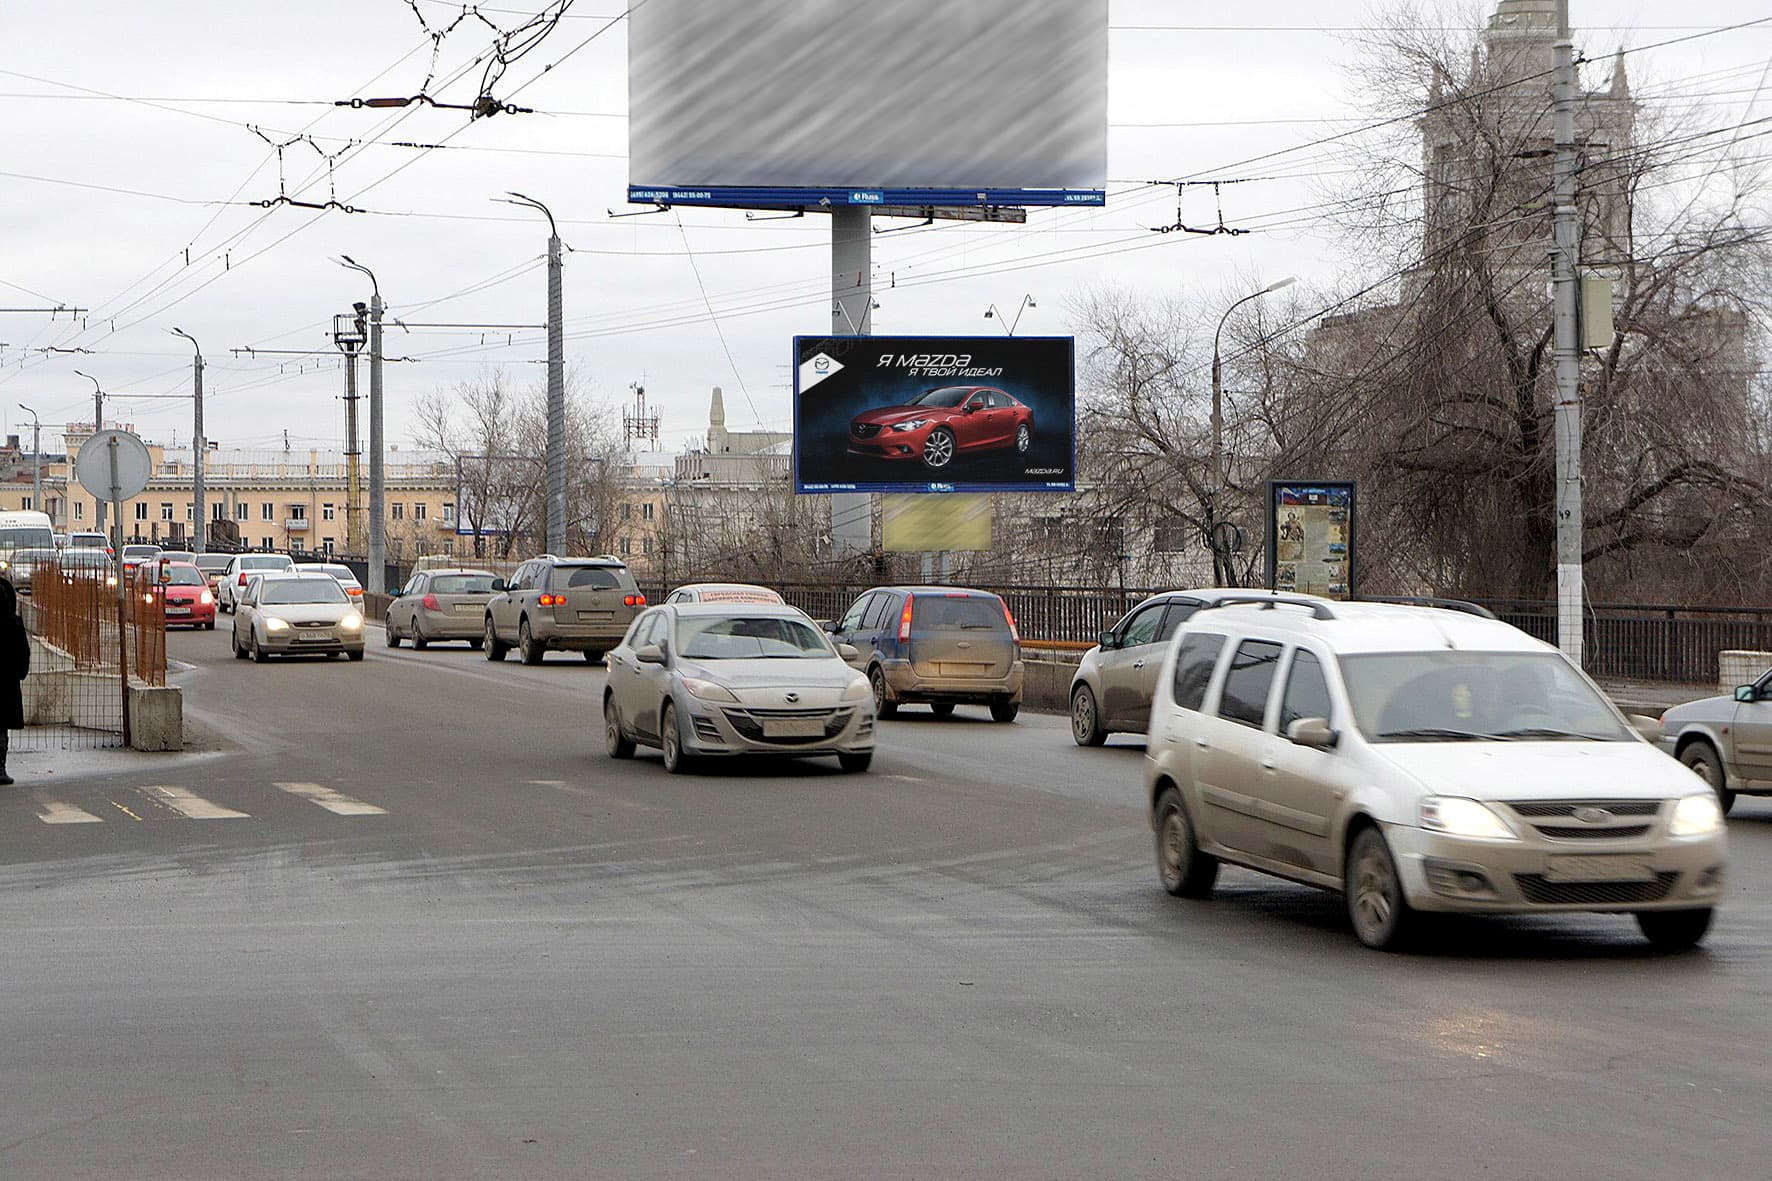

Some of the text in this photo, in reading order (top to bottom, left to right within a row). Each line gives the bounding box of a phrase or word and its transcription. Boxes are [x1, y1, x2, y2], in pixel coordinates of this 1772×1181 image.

[876, 354, 894, 367] Я
[908, 366, 1003, 377] Я ТВОЙ ИДЕАЛ
